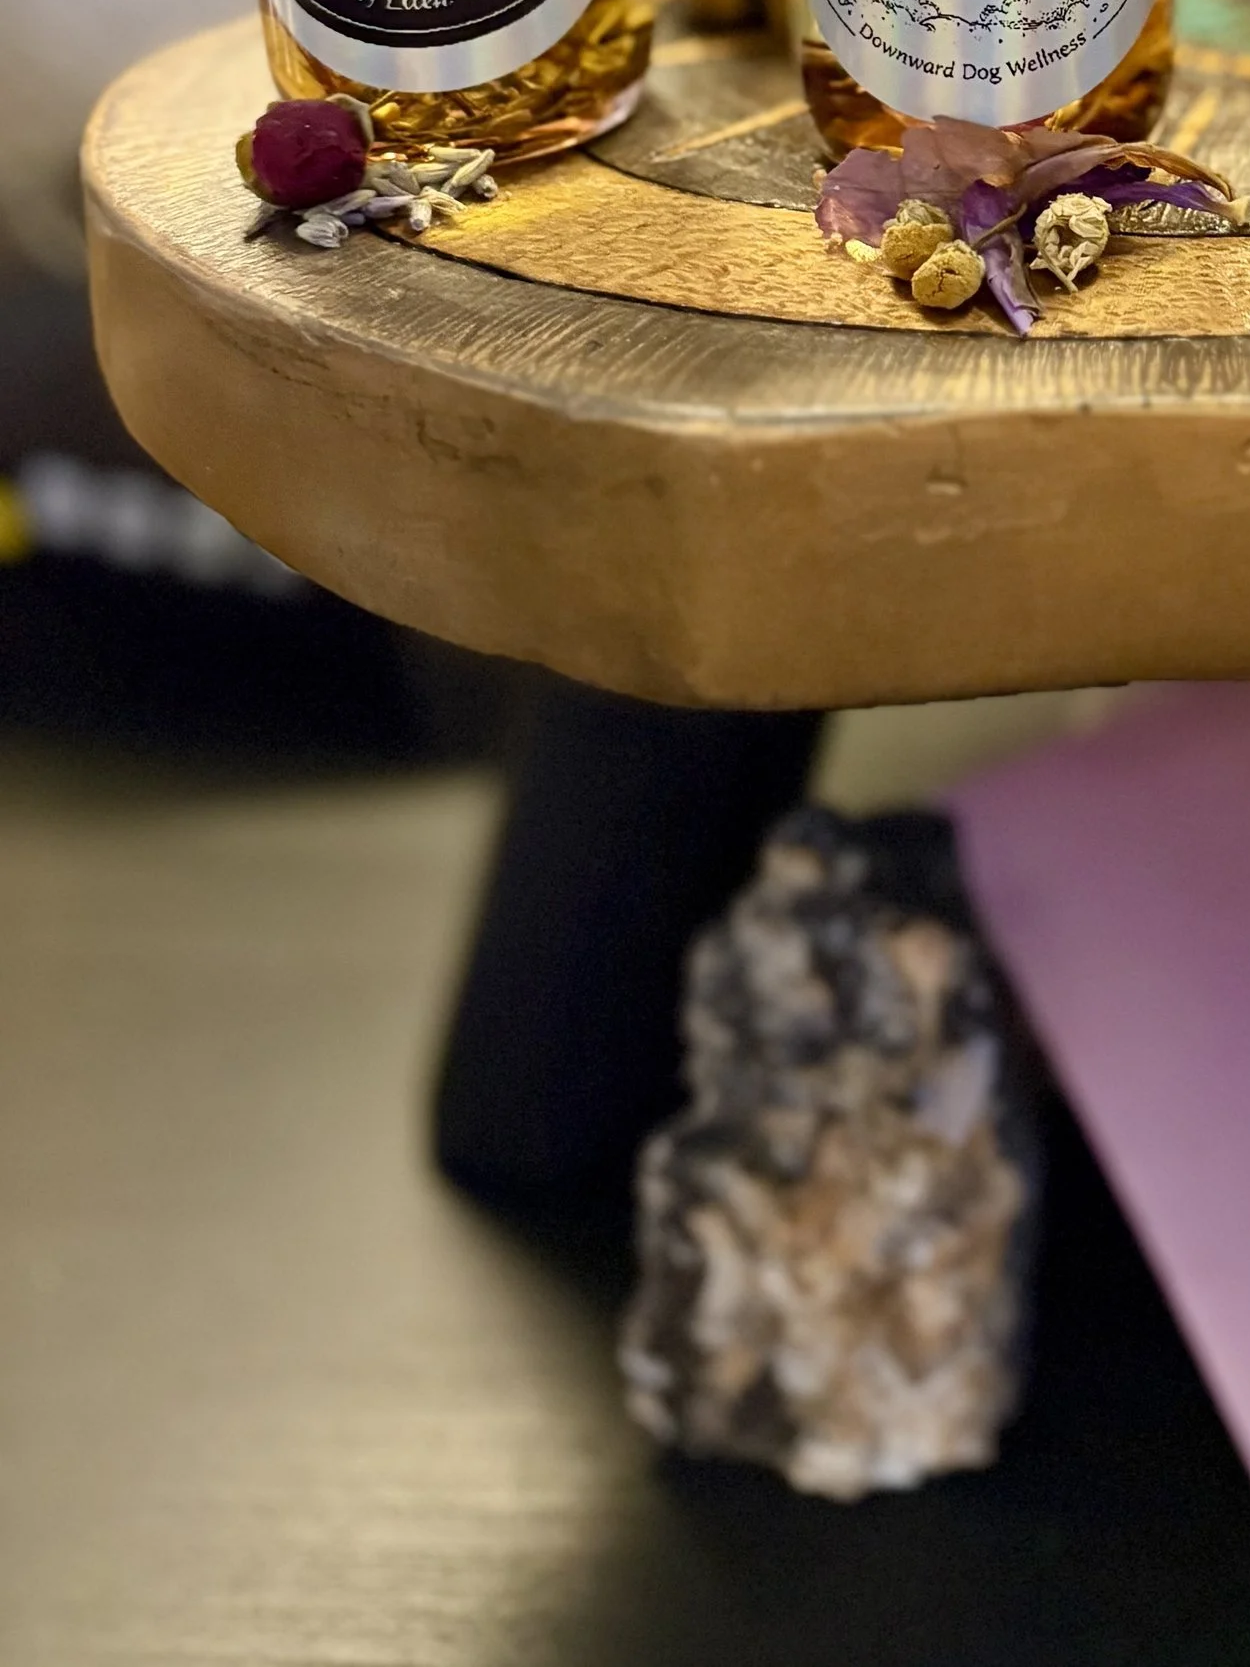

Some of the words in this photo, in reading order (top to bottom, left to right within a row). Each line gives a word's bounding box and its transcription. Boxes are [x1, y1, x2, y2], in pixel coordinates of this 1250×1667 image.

[859, 23, 955, 78] Downward
[962, 63, 1002, 85] Dog
[1006, 31, 1087, 77] Wellness
